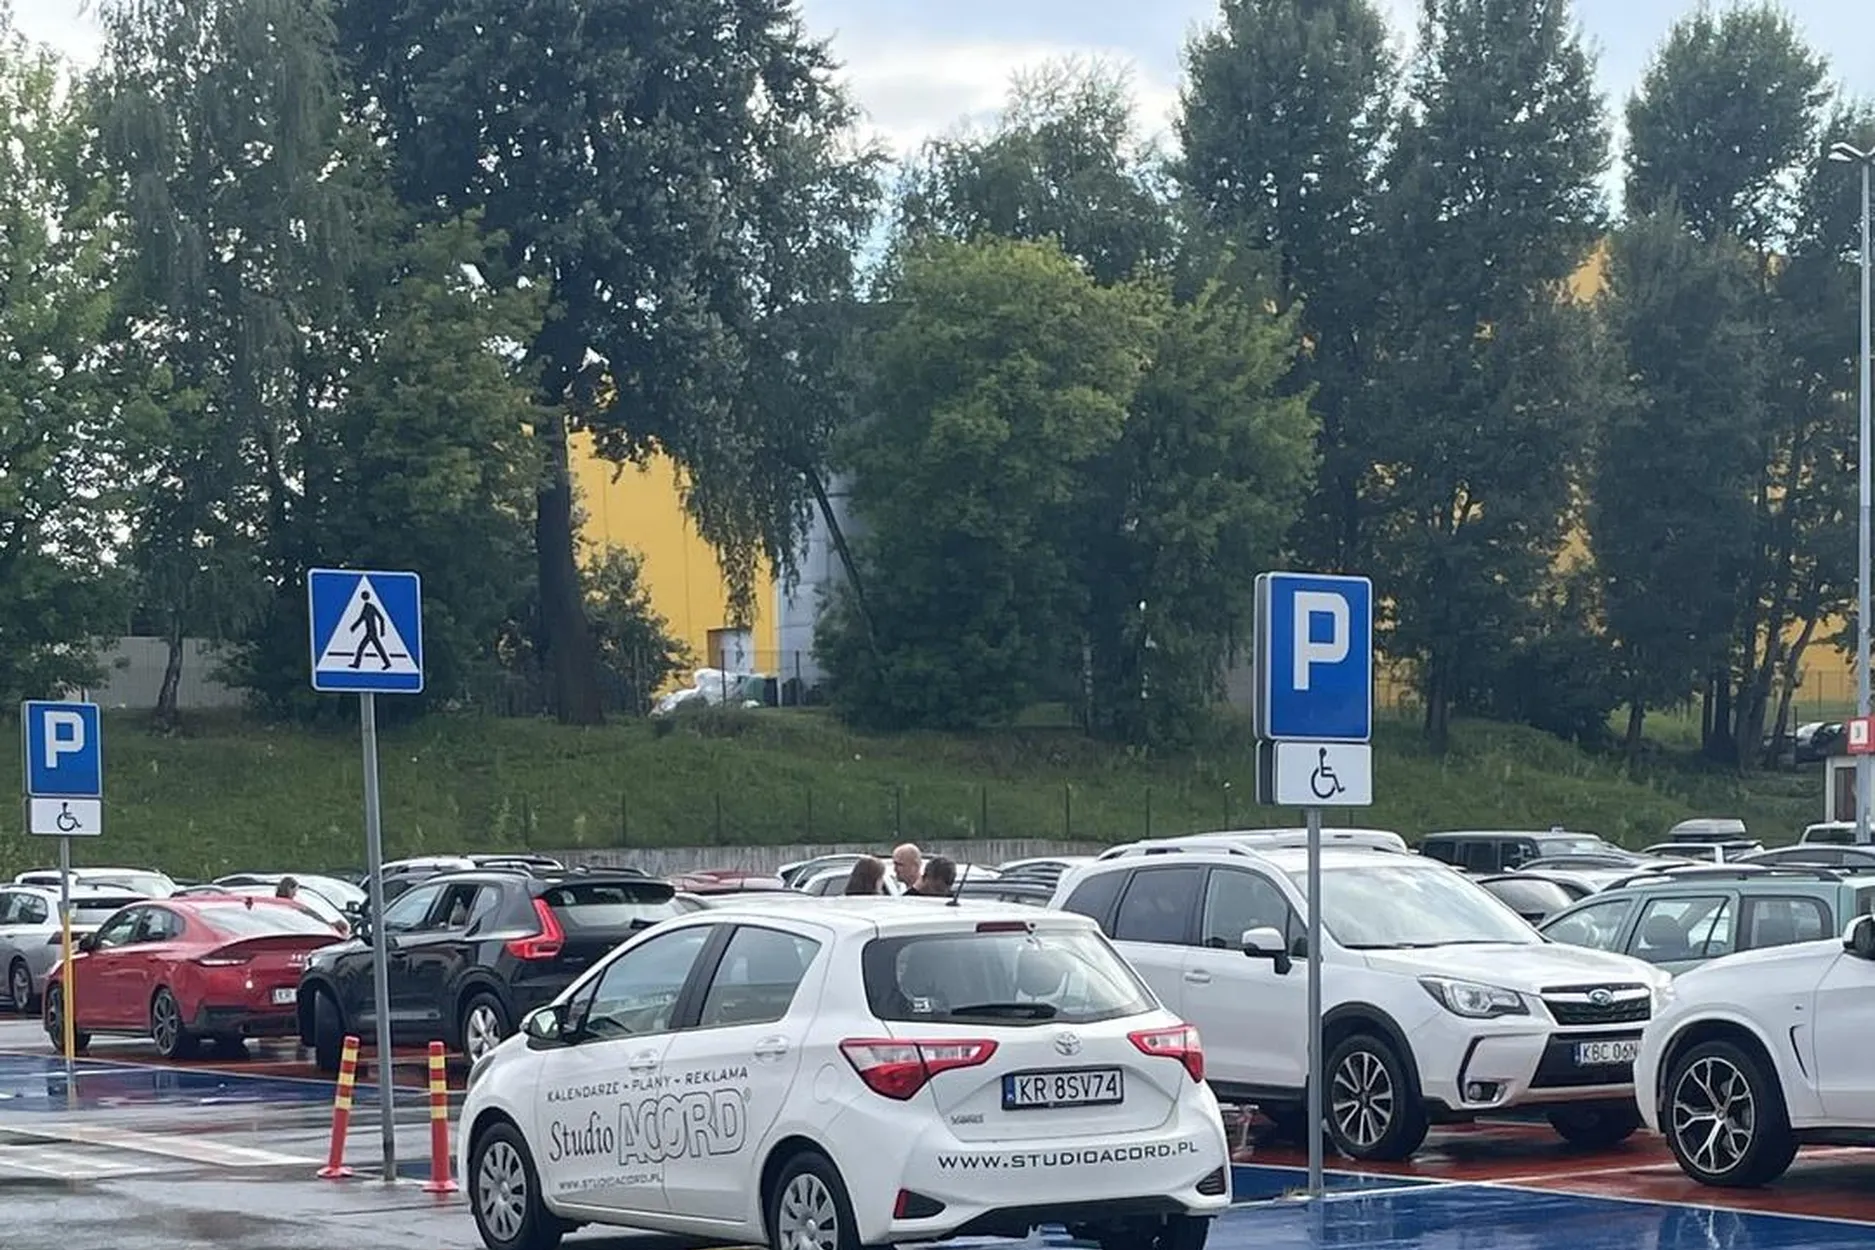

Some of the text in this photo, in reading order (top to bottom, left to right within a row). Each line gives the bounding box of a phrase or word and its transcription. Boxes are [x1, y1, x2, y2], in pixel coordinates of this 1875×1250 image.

[1293, 591, 1350, 690] P
[44, 710, 84, 768] P
[547, 1066, 748, 1101] KALENDARZE PLANY REKLAMA
[1019, 1073, 1117, 1101] KR 8SV74
[549, 1111, 614, 1162] Studio
[938, 1142, 1199, 1169] WWW.STUDIOACORD.PL
